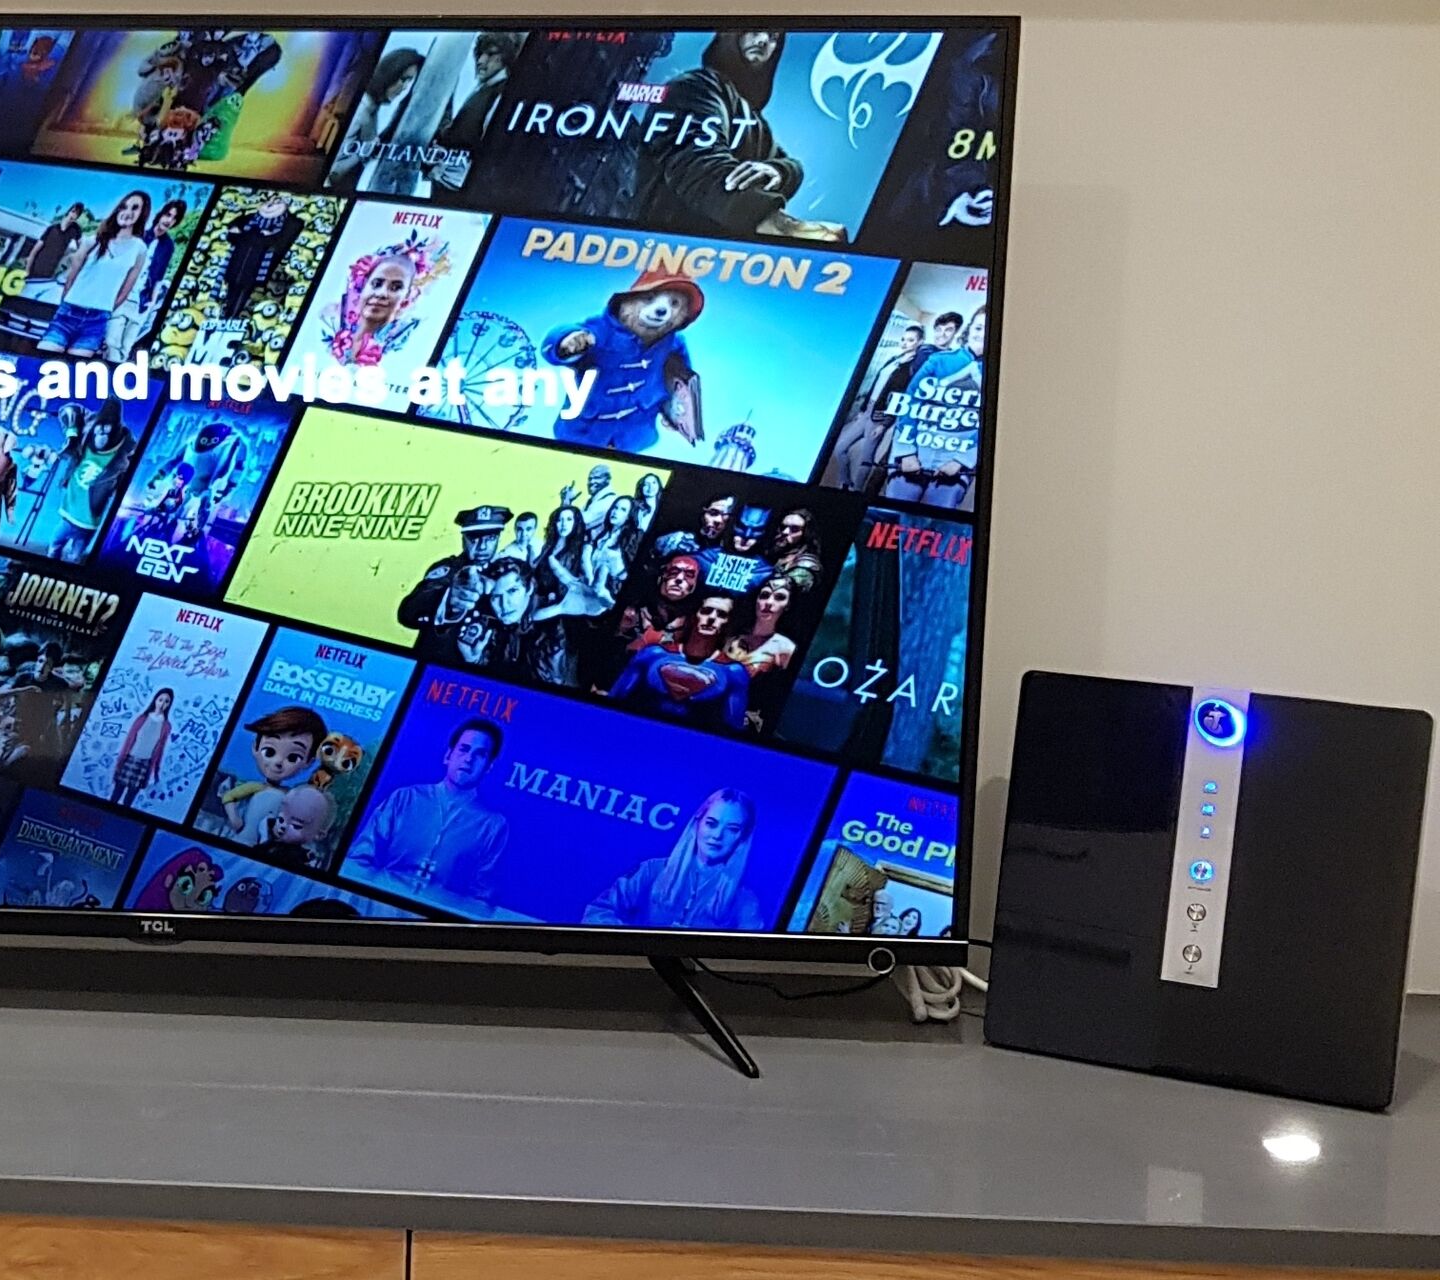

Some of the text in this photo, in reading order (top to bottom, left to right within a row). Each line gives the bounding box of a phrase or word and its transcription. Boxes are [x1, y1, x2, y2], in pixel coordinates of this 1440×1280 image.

[616, 83, 667, 104] MARVEL
[507, 101, 758, 150] IRON FIST
[343, 140, 472, 170] OUTLANDER
[947, 128, 976, 160] 8
[392, 211, 444, 230] NETFLIX
[814, 260, 853, 296] 2
[37, 350, 149, 401] and
[169, 352, 389, 403] movies
[408, 358, 466, 407] at
[480, 362, 598, 420] any
[883, 391, 980, 431] Burge
[897, 423, 975, 453] Loser
[282, 480, 442, 519] BROOKLYN
[274, 514, 427, 541] NINE-NINE
[125, 535, 196, 564] NEXT
[866, 521, 973, 567] NETFLIX
[136, 556, 200, 584] GEN
[705, 563, 752, 593] LEAGUE
[714, 552, 760, 576] JUSTICE
[176, 608, 224, 633] NETFLIX
[315, 643, 368, 670] NETFLIX
[268, 659, 331, 693] BOSS
[329, 675, 397, 710] BABY
[262, 680, 384, 723] BACK IN BUSINESS
[426, 678, 519, 723] NETFLIX
[505, 761, 681, 831] MANIAC
[841, 819, 924, 858] Good
[875, 811, 913, 835] The
[16, 820, 125, 870] DISENCHANTMENT
[140, 920, 174, 933] TCL
